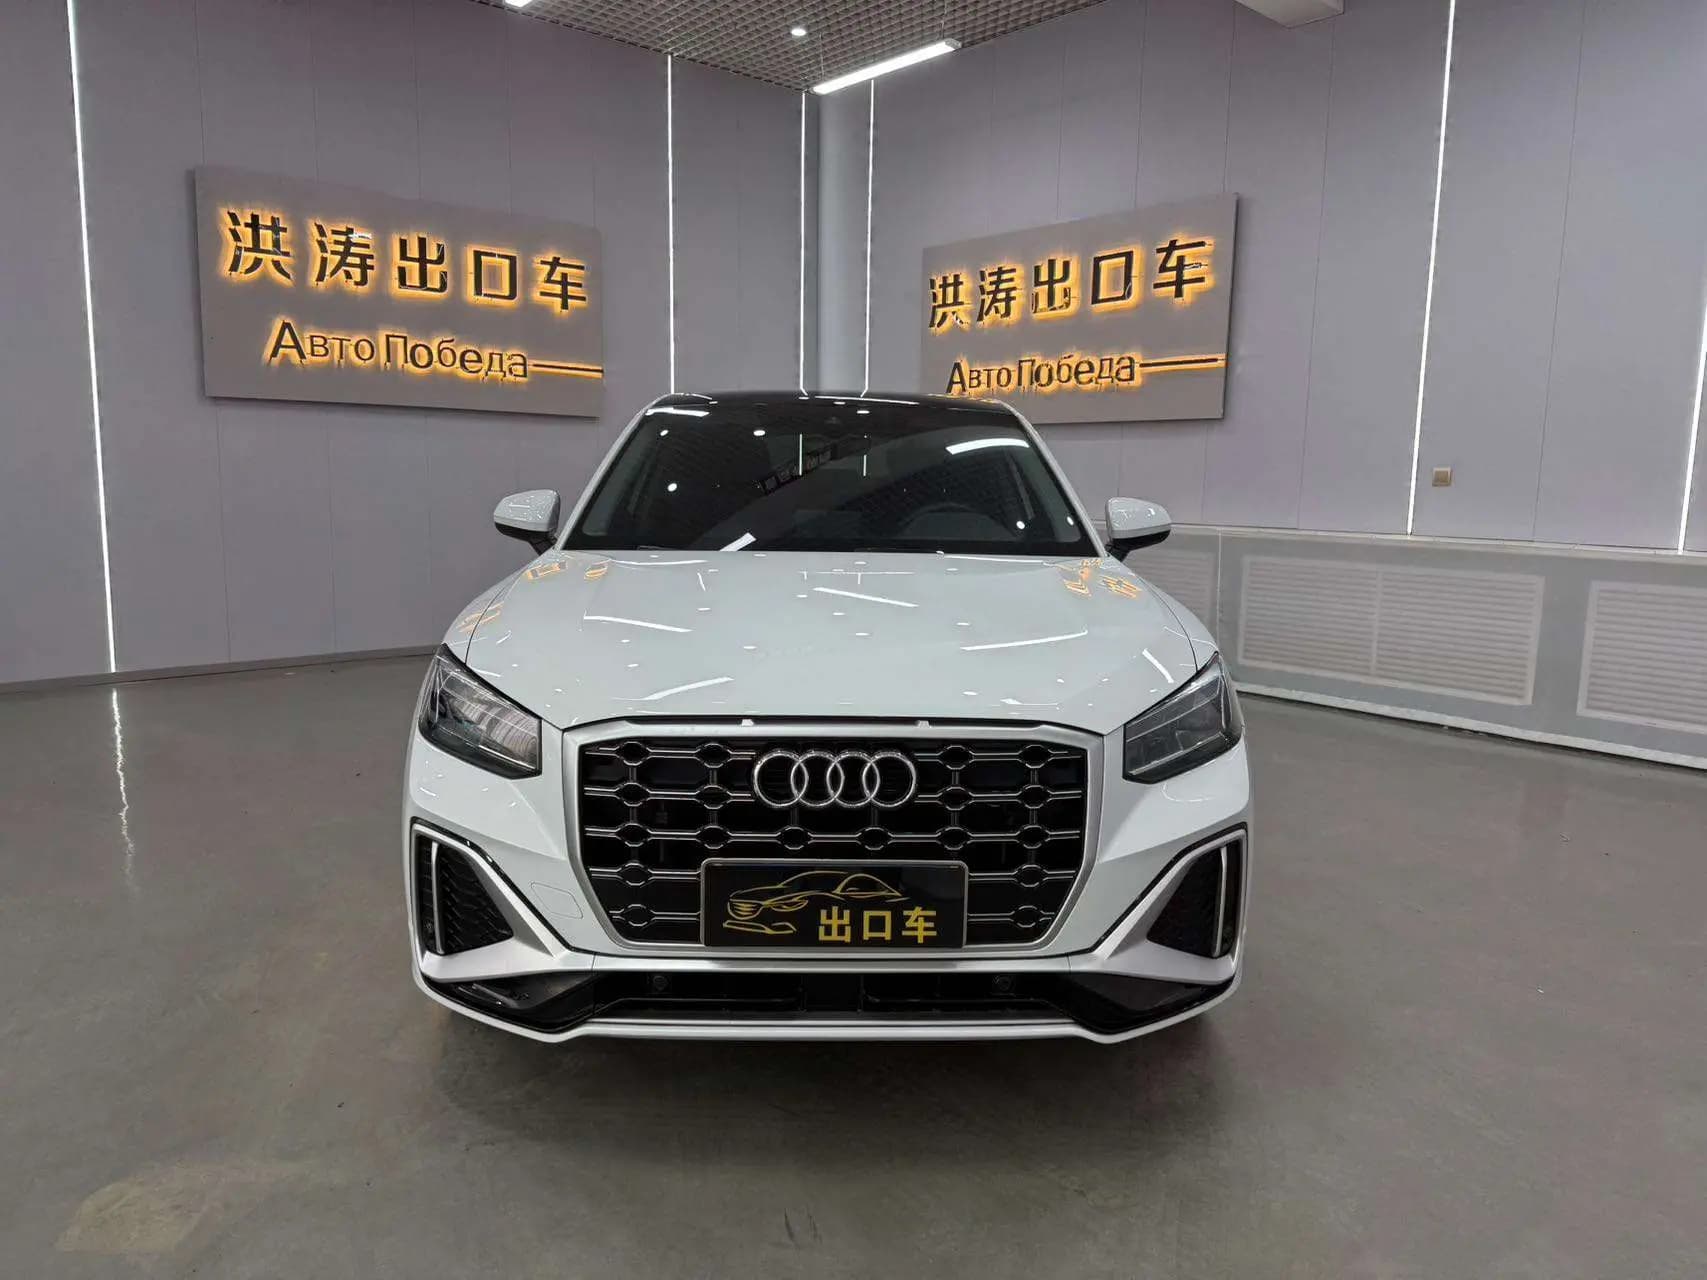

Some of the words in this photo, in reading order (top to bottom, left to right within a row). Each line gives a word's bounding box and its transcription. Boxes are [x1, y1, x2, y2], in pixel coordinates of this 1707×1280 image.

[226, 210, 588, 312] 洪涛出口车
[928, 238, 1208, 329] 洪涛出口车
[818, 905, 938, 944] 出口车
